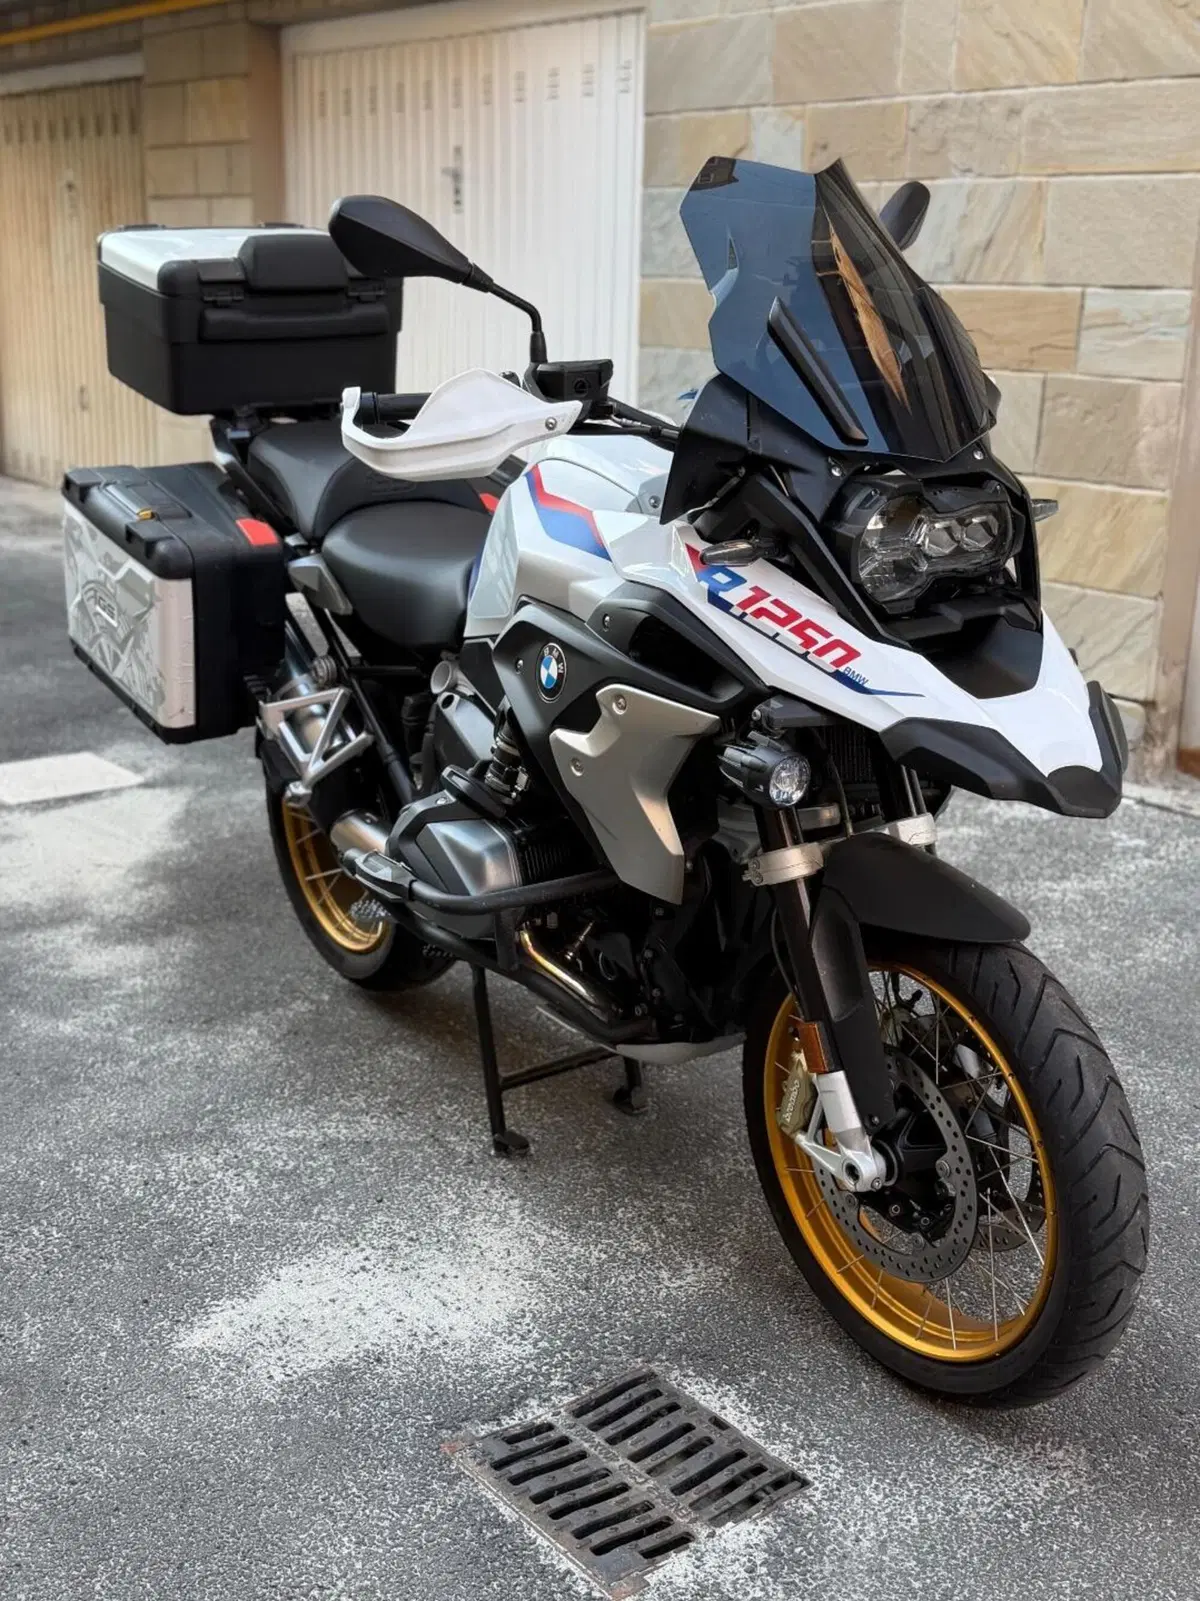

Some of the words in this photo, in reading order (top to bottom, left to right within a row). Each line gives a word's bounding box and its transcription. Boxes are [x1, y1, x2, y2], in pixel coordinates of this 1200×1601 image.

[731, 585, 862, 672] 1250
[843, 666, 869, 686] BMW
[782, 1079, 800, 1123] brembo
